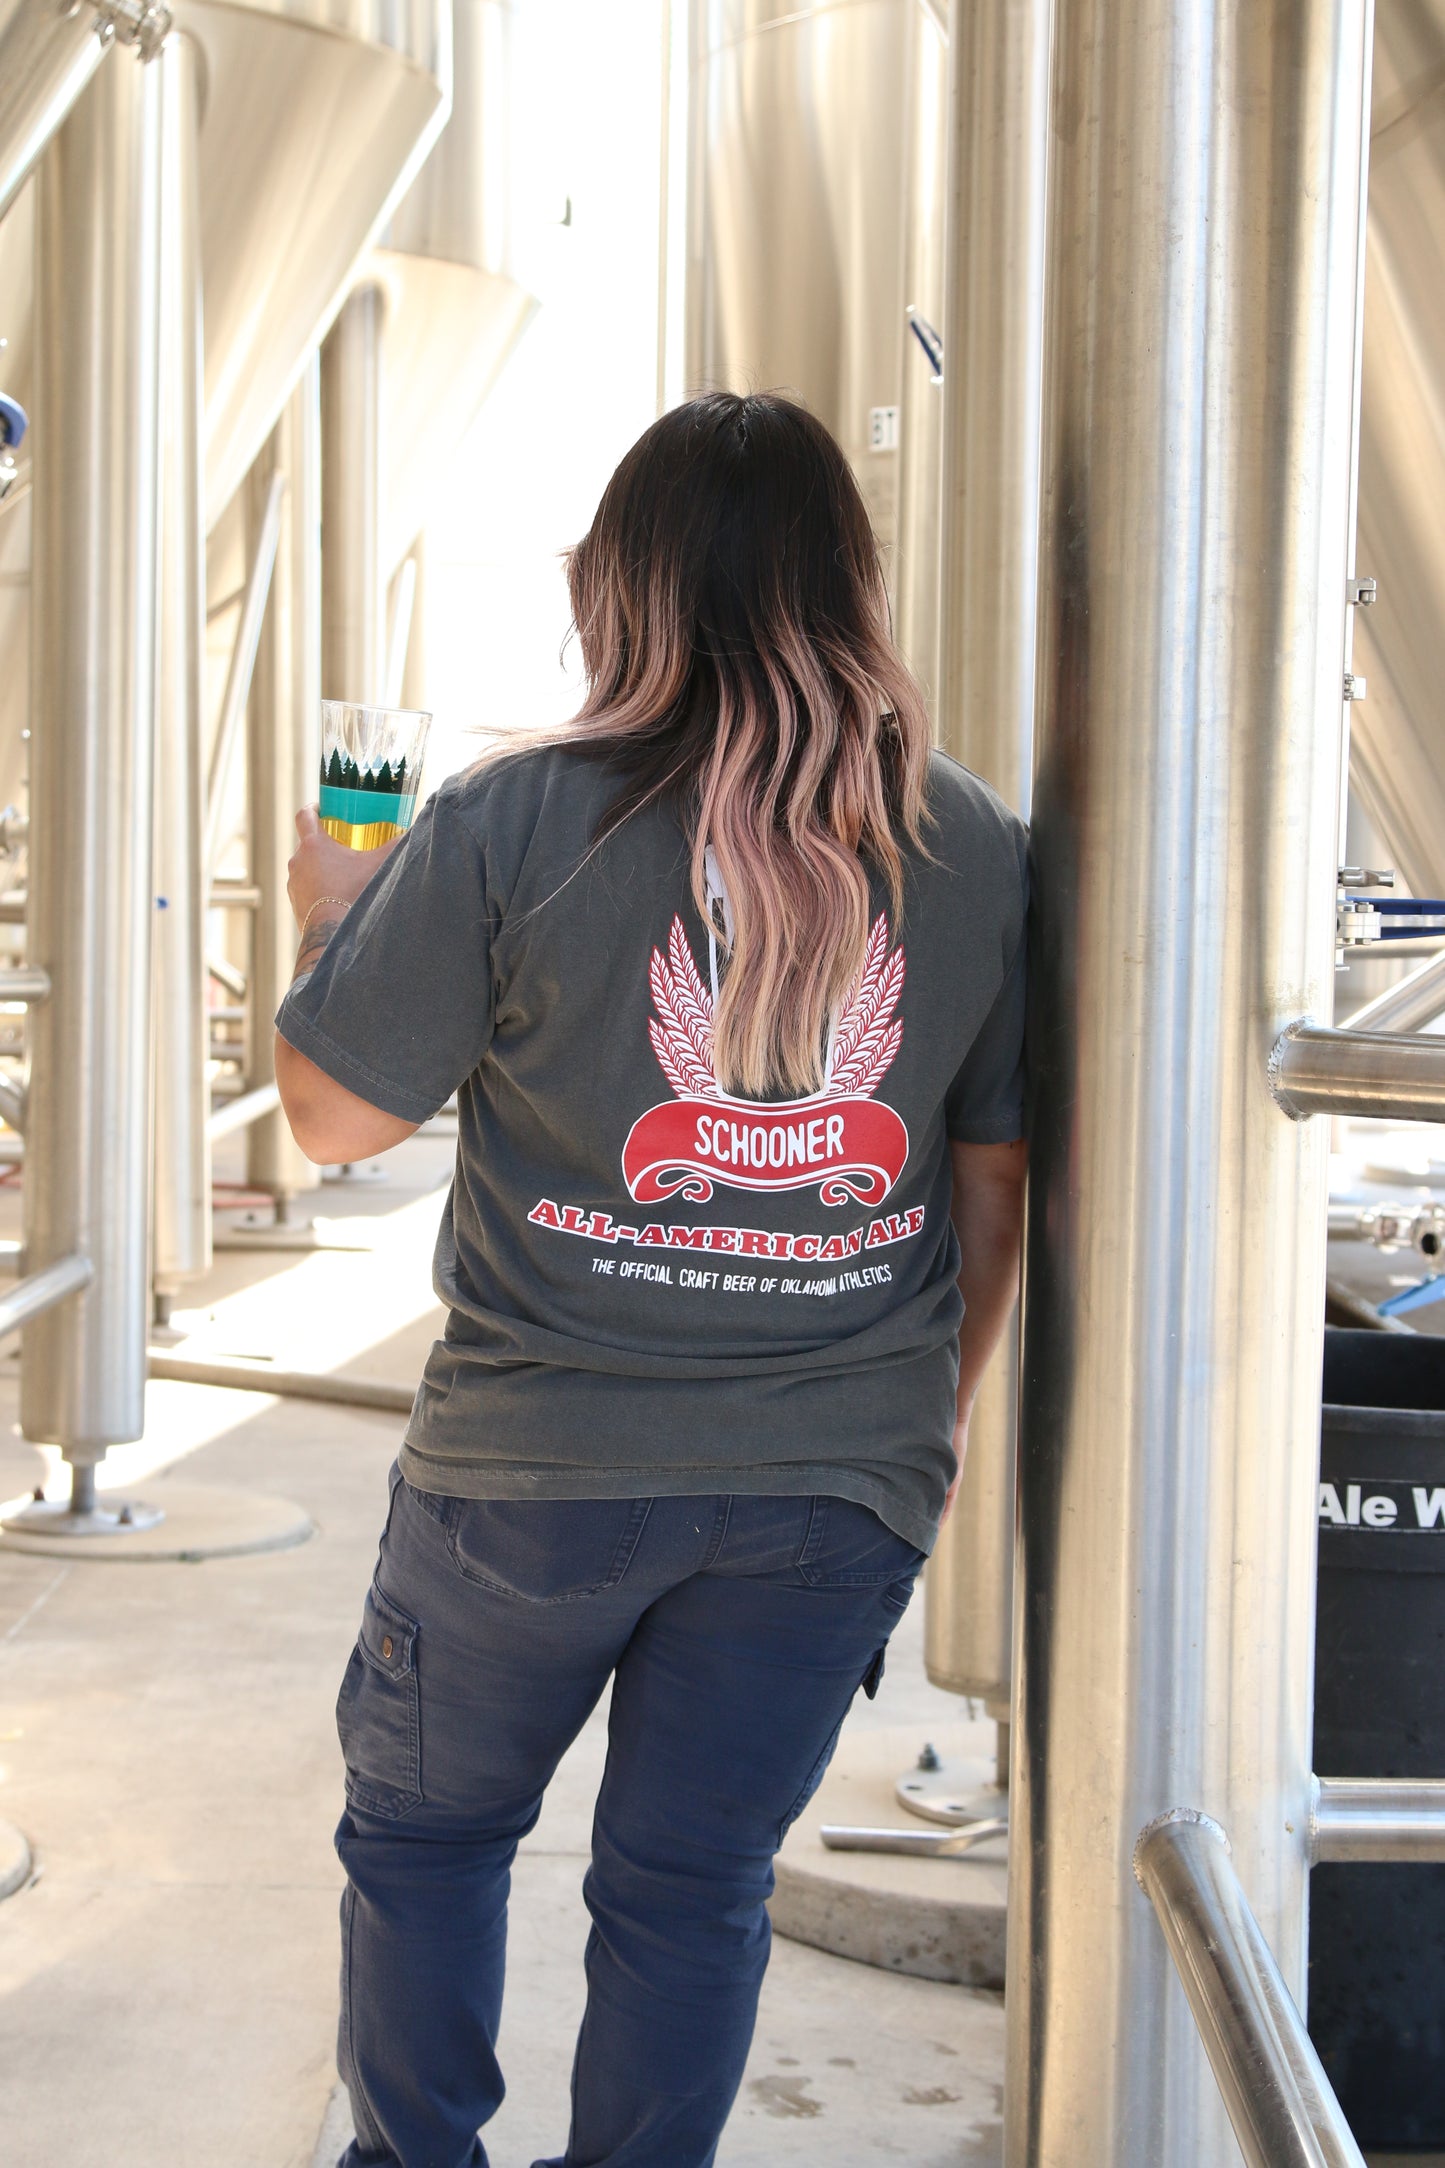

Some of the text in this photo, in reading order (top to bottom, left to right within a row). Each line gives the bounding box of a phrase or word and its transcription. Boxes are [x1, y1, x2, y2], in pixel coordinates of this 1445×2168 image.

[694, 1114, 845, 1168] SCHOONER
[527, 1198, 925, 1262] ALL-AMERICAN ALE
[592, 1258, 893, 1297] THE OFFICIAL CRAFT BEER OF OKLAHOMA ATHLETICS
[1318, 1482, 1398, 1527] Ale
